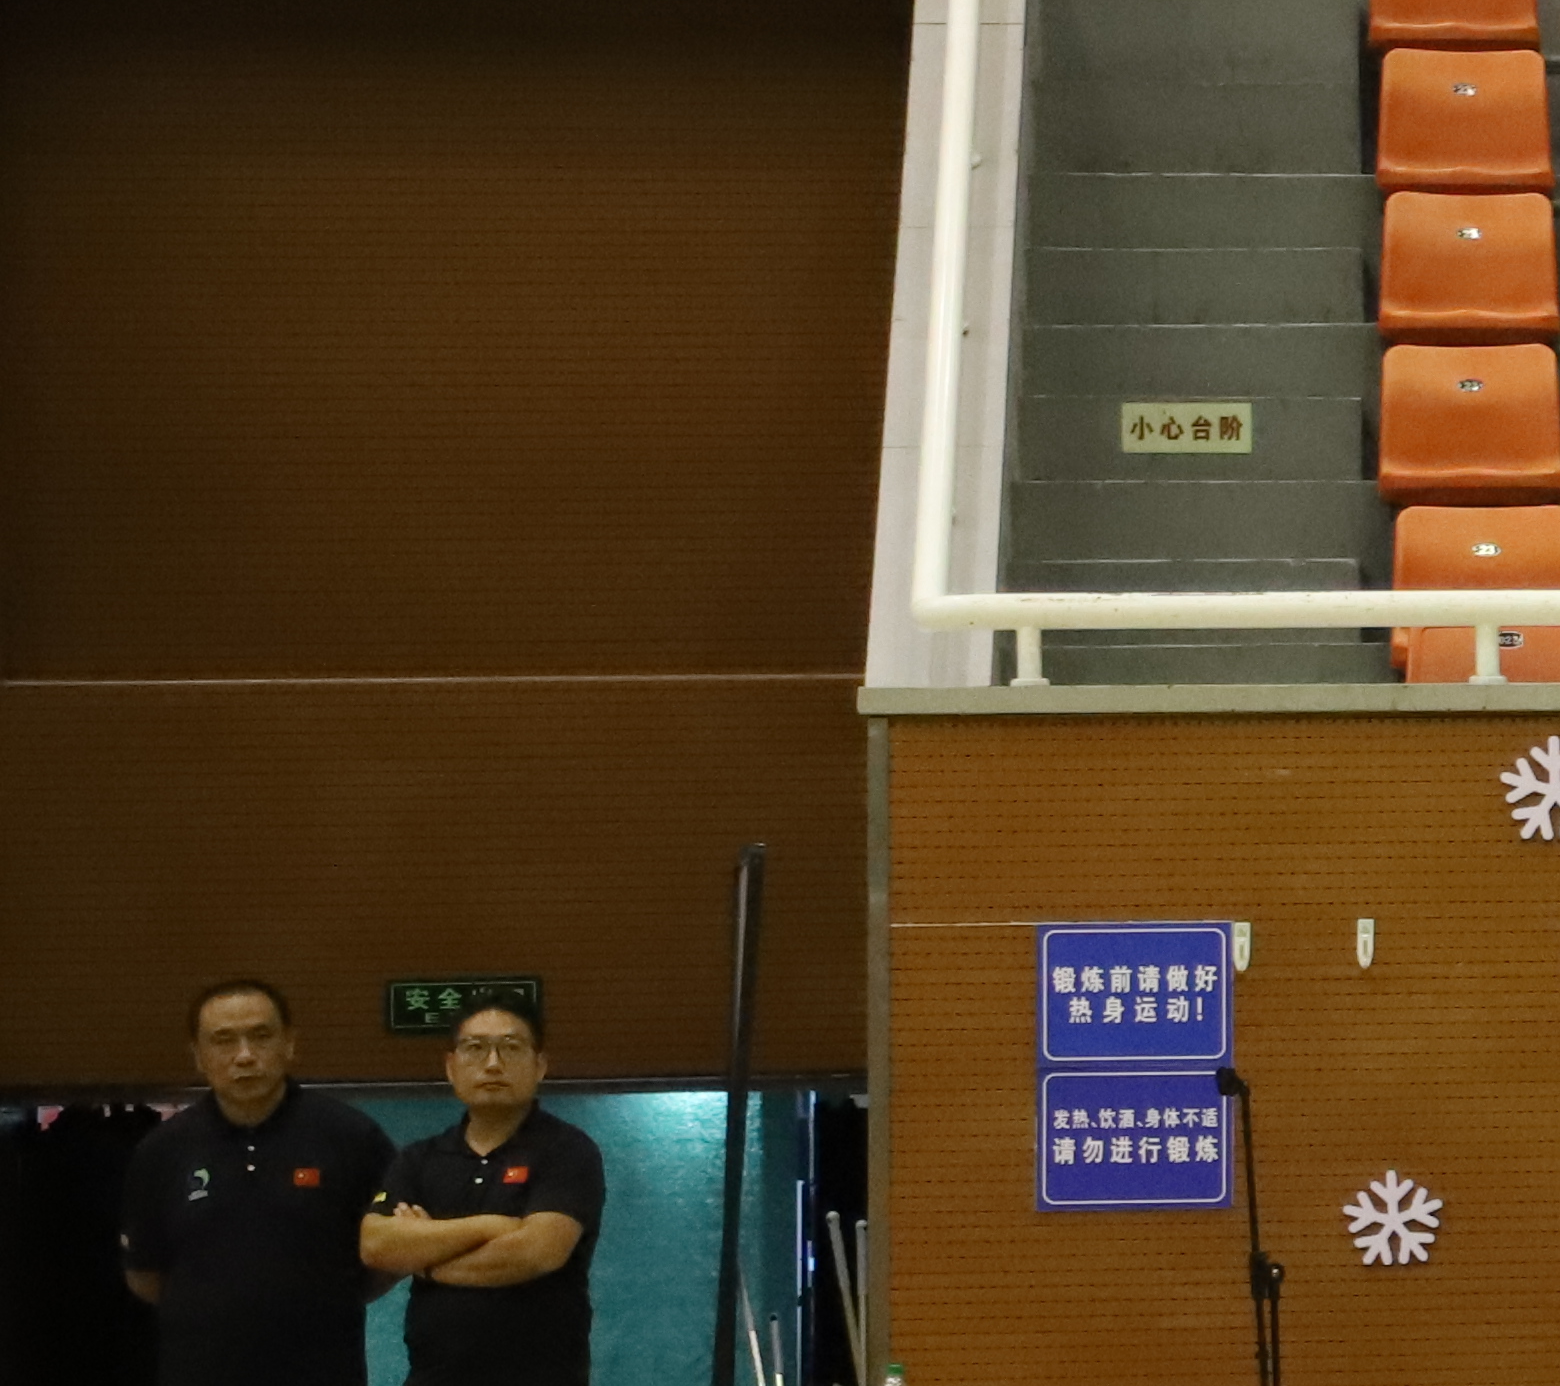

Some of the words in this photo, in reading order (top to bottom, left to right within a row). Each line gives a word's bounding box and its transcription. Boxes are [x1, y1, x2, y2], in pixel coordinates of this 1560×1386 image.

[1130, 415, 1243, 441] 小心台阶
[1052, 965, 1218, 994] 锻炼前请做好
[1053, 1107, 1219, 1130] 发热、饮酒、身体不适
[1052, 1135, 1220, 1165] 请勿进行锻炼
